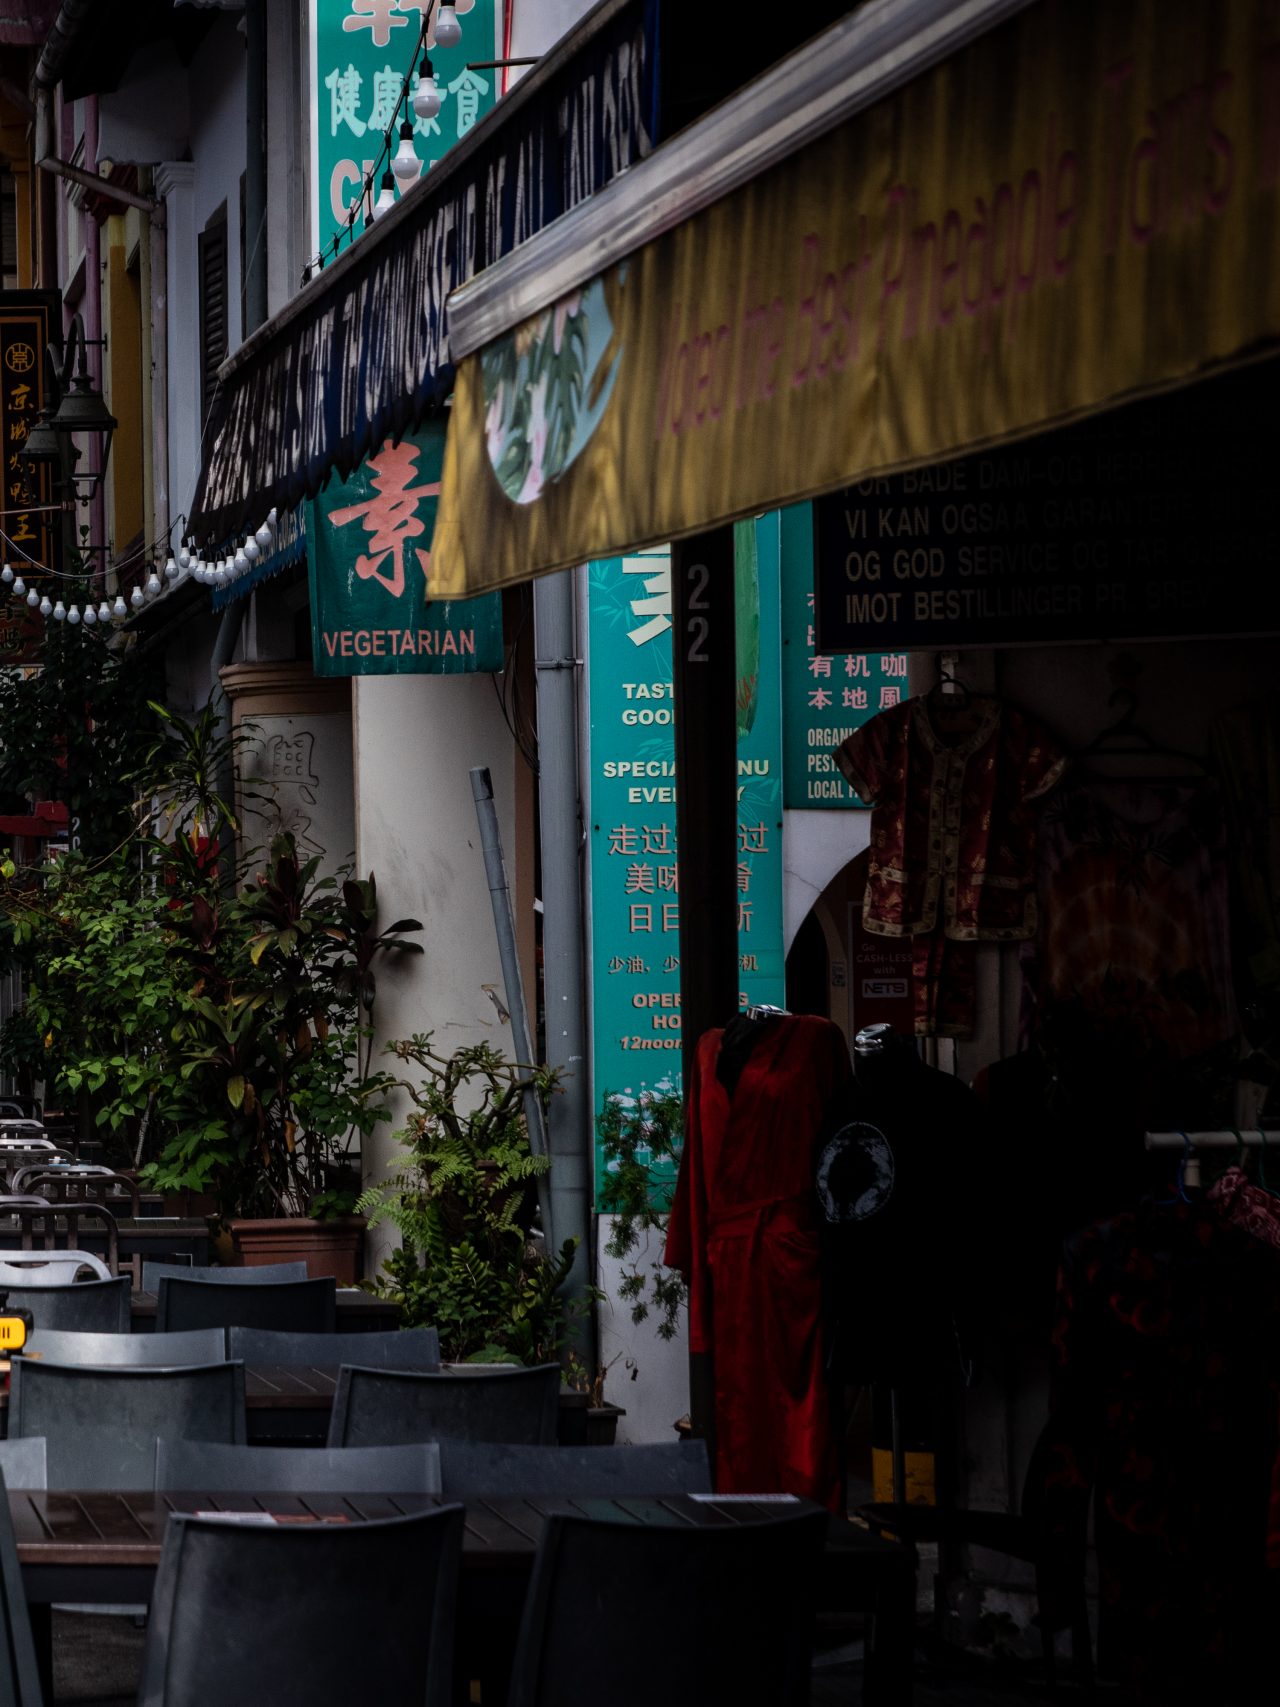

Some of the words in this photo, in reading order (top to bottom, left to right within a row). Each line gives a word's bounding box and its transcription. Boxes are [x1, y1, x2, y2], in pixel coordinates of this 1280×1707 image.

[793, 215, 873, 387] Best
[877, 112, 1079, 358] Pineapple
[1104, 58, 1235, 254] Tarts
[845, 509, 868, 539] VI
[878, 505, 931, 539] KAN
[942, 501, 1030, 535] OGSAA
[845, 550, 882, 583] OG
[892, 547, 946, 580] GOD
[957, 543, 1061, 578] SERVICE
[845, 592, 903, 625] IMOT
[914, 583, 1084, 622] BESTILLINGER
[323, 629, 476, 657] VEGETARIAN
[622, 709, 675, 725] GOO
[807, 780, 844, 799] LOCAL
[861, 943, 876, 952] Go
[855, 953, 913, 964] CASH-LESS
[872, 965, 896, 975] with
[865, 982, 905, 994] NETS
